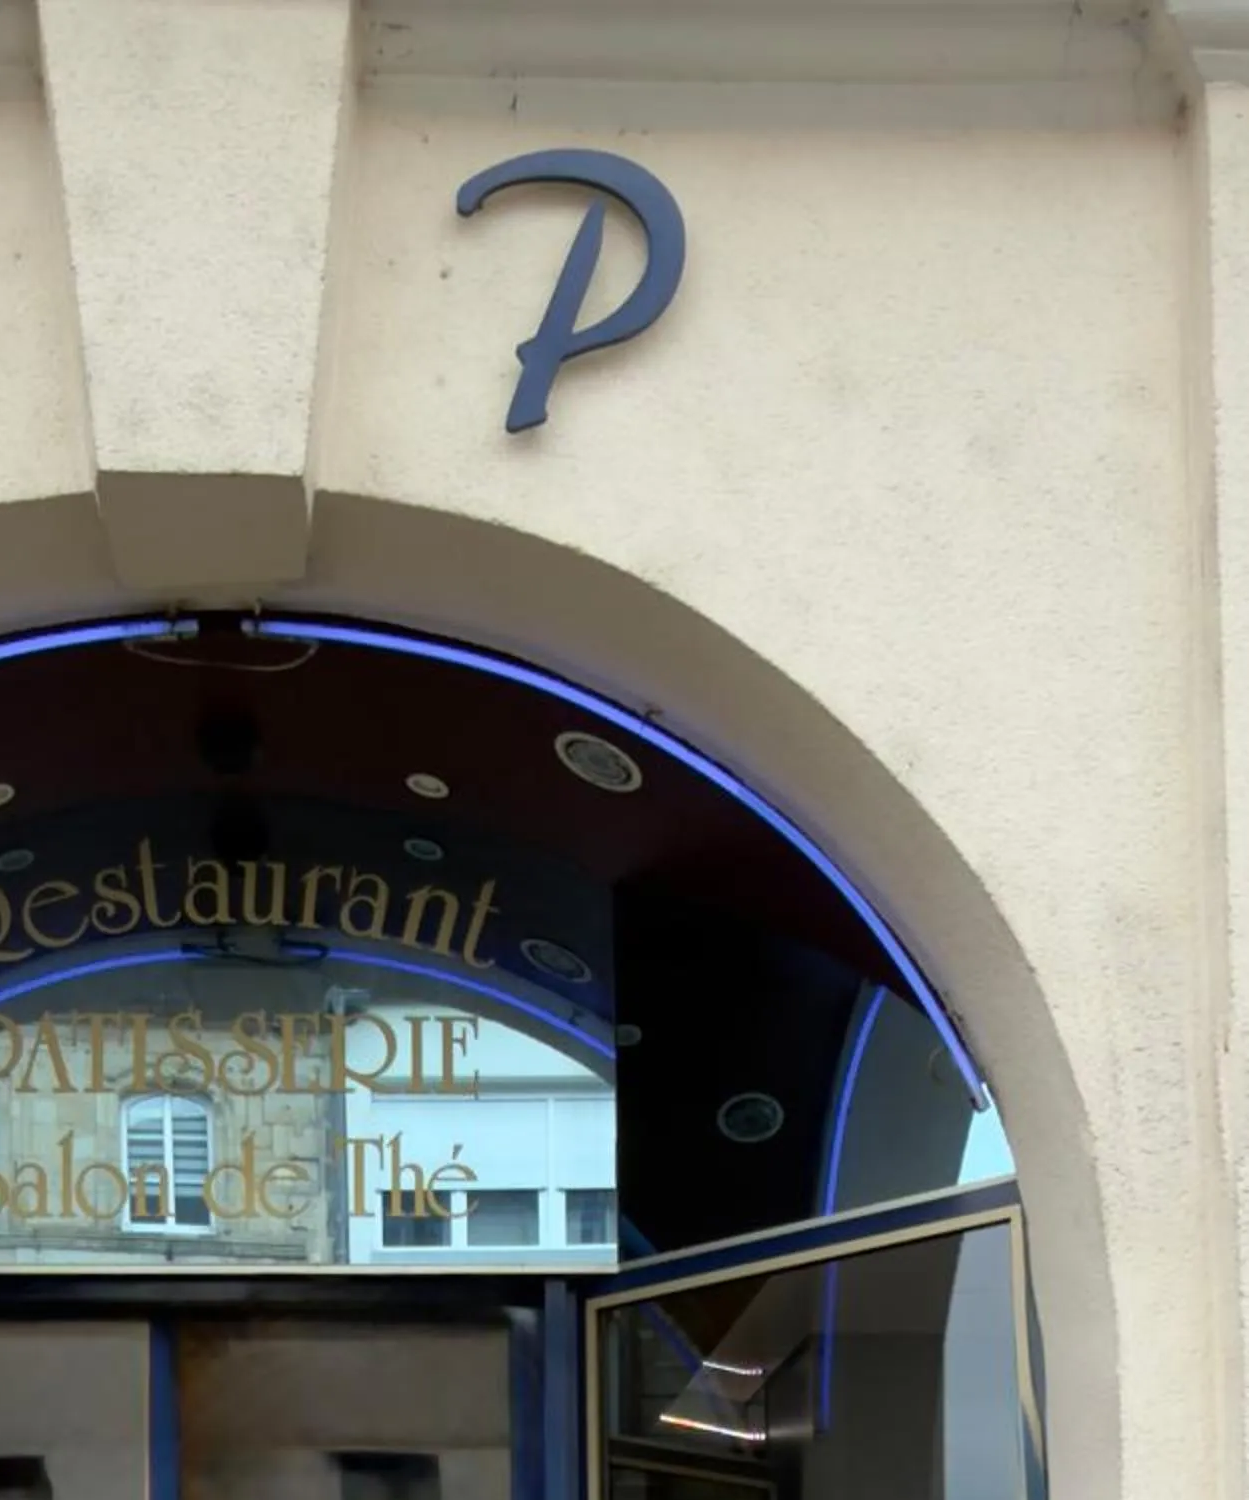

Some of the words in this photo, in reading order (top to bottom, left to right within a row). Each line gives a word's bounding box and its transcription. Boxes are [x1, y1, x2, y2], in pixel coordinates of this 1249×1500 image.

[456, 147, 687, 434] P
[203, 1129, 312, 1219] de
[333, 1130, 480, 1219] Thé
